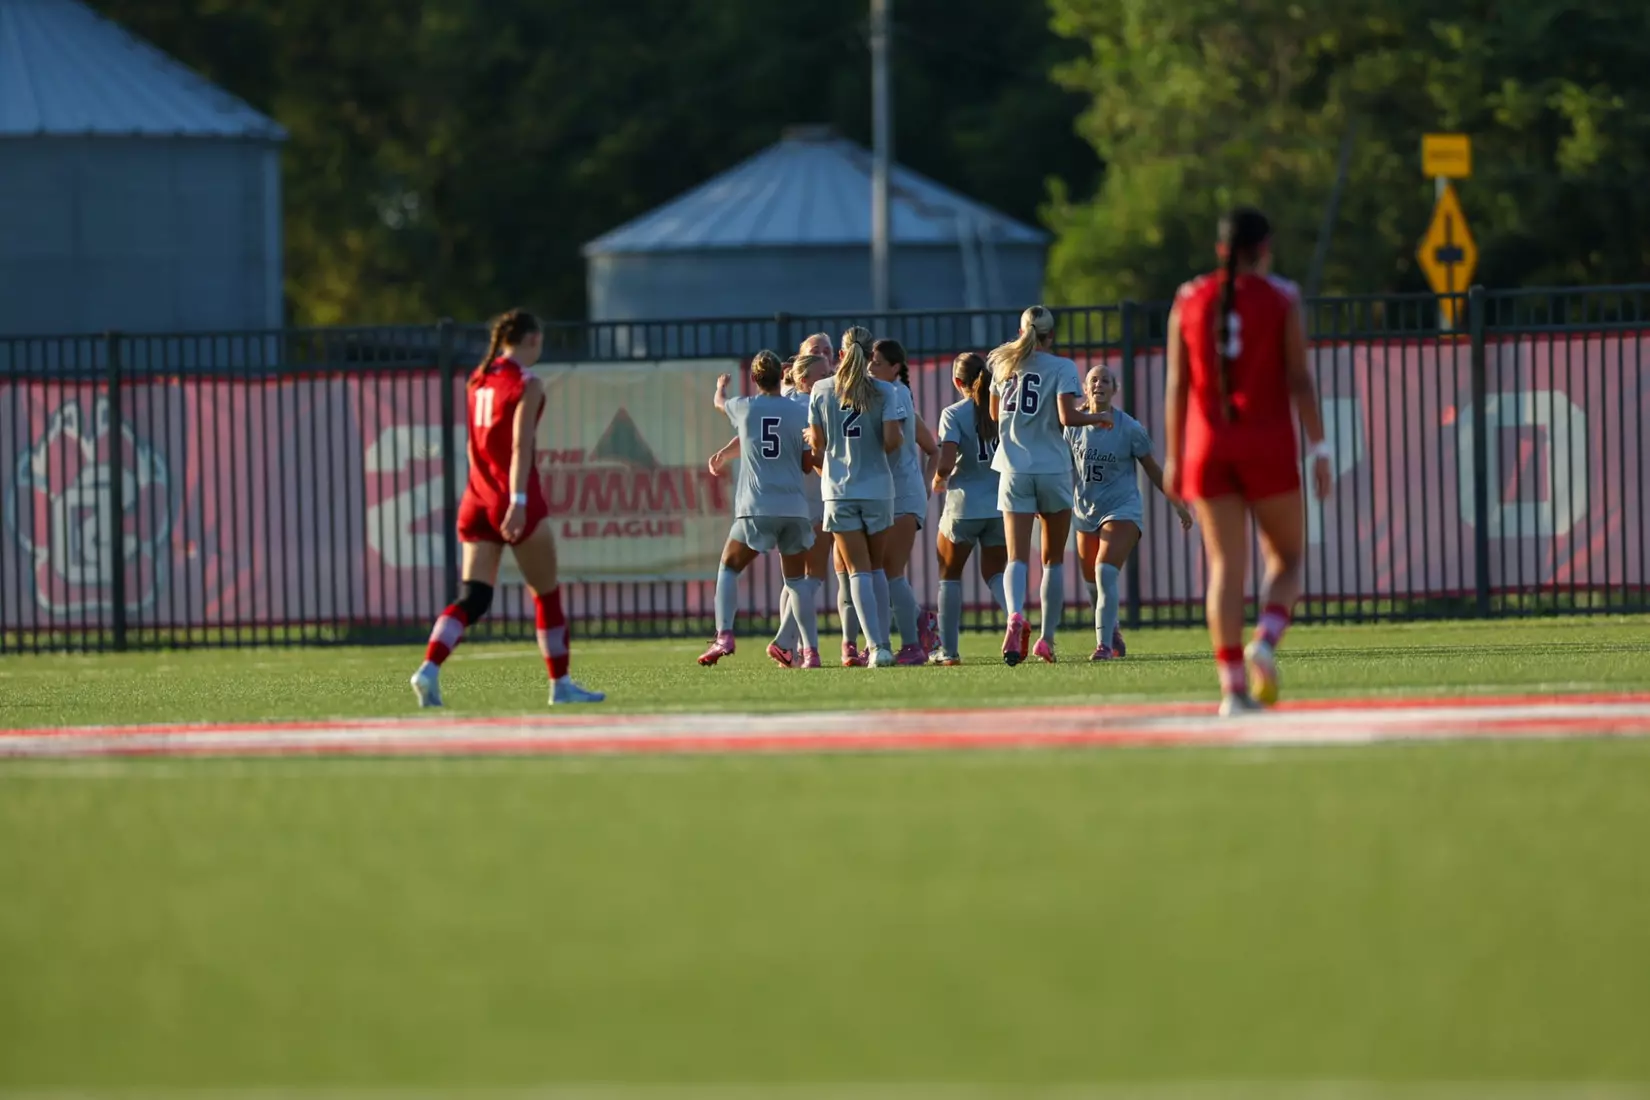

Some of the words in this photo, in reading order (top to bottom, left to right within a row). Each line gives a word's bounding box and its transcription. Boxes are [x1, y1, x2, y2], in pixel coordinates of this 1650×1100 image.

[475, 387, 495, 428] 11
[1000, 369, 1042, 416] 26
[761, 416, 781, 460] 5
[839, 403, 863, 439] 2
[537, 450, 585, 464] THE
[1085, 464, 1104, 483] 15
[541, 468, 732, 513] UMMIT
[562, 520, 684, 540] LEAGUE
